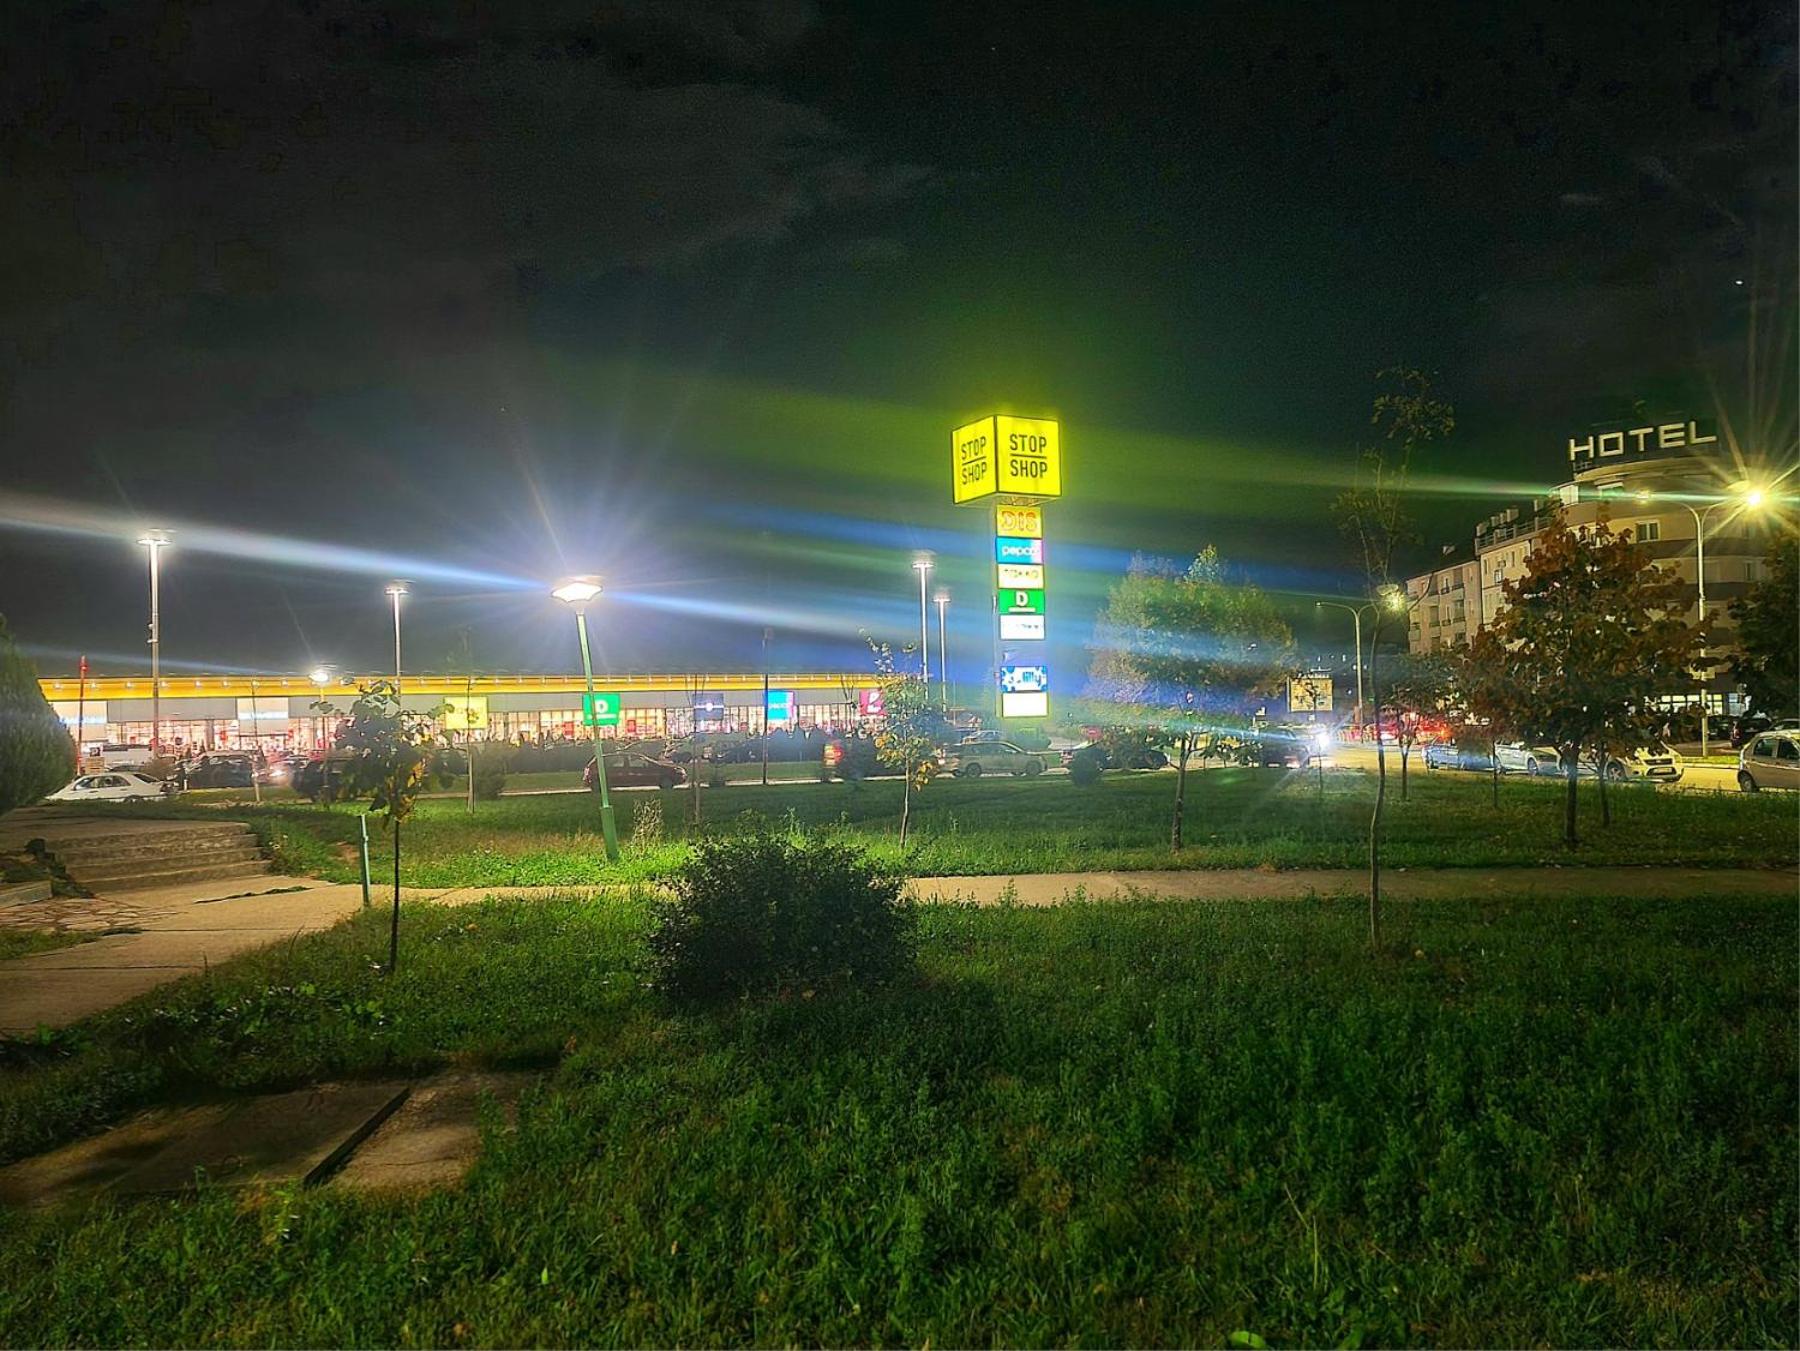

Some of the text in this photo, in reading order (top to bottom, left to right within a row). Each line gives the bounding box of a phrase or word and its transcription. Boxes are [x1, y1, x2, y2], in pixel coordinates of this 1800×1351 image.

[960, 435, 987, 460] STOP
[1009, 433, 1047, 453] STOP
[1568, 420, 1718, 461] HOTEL
[961, 461, 988, 485] SHOP
[1010, 459, 1048, 478] SHOP
[1015, 590, 1029, 607] D
